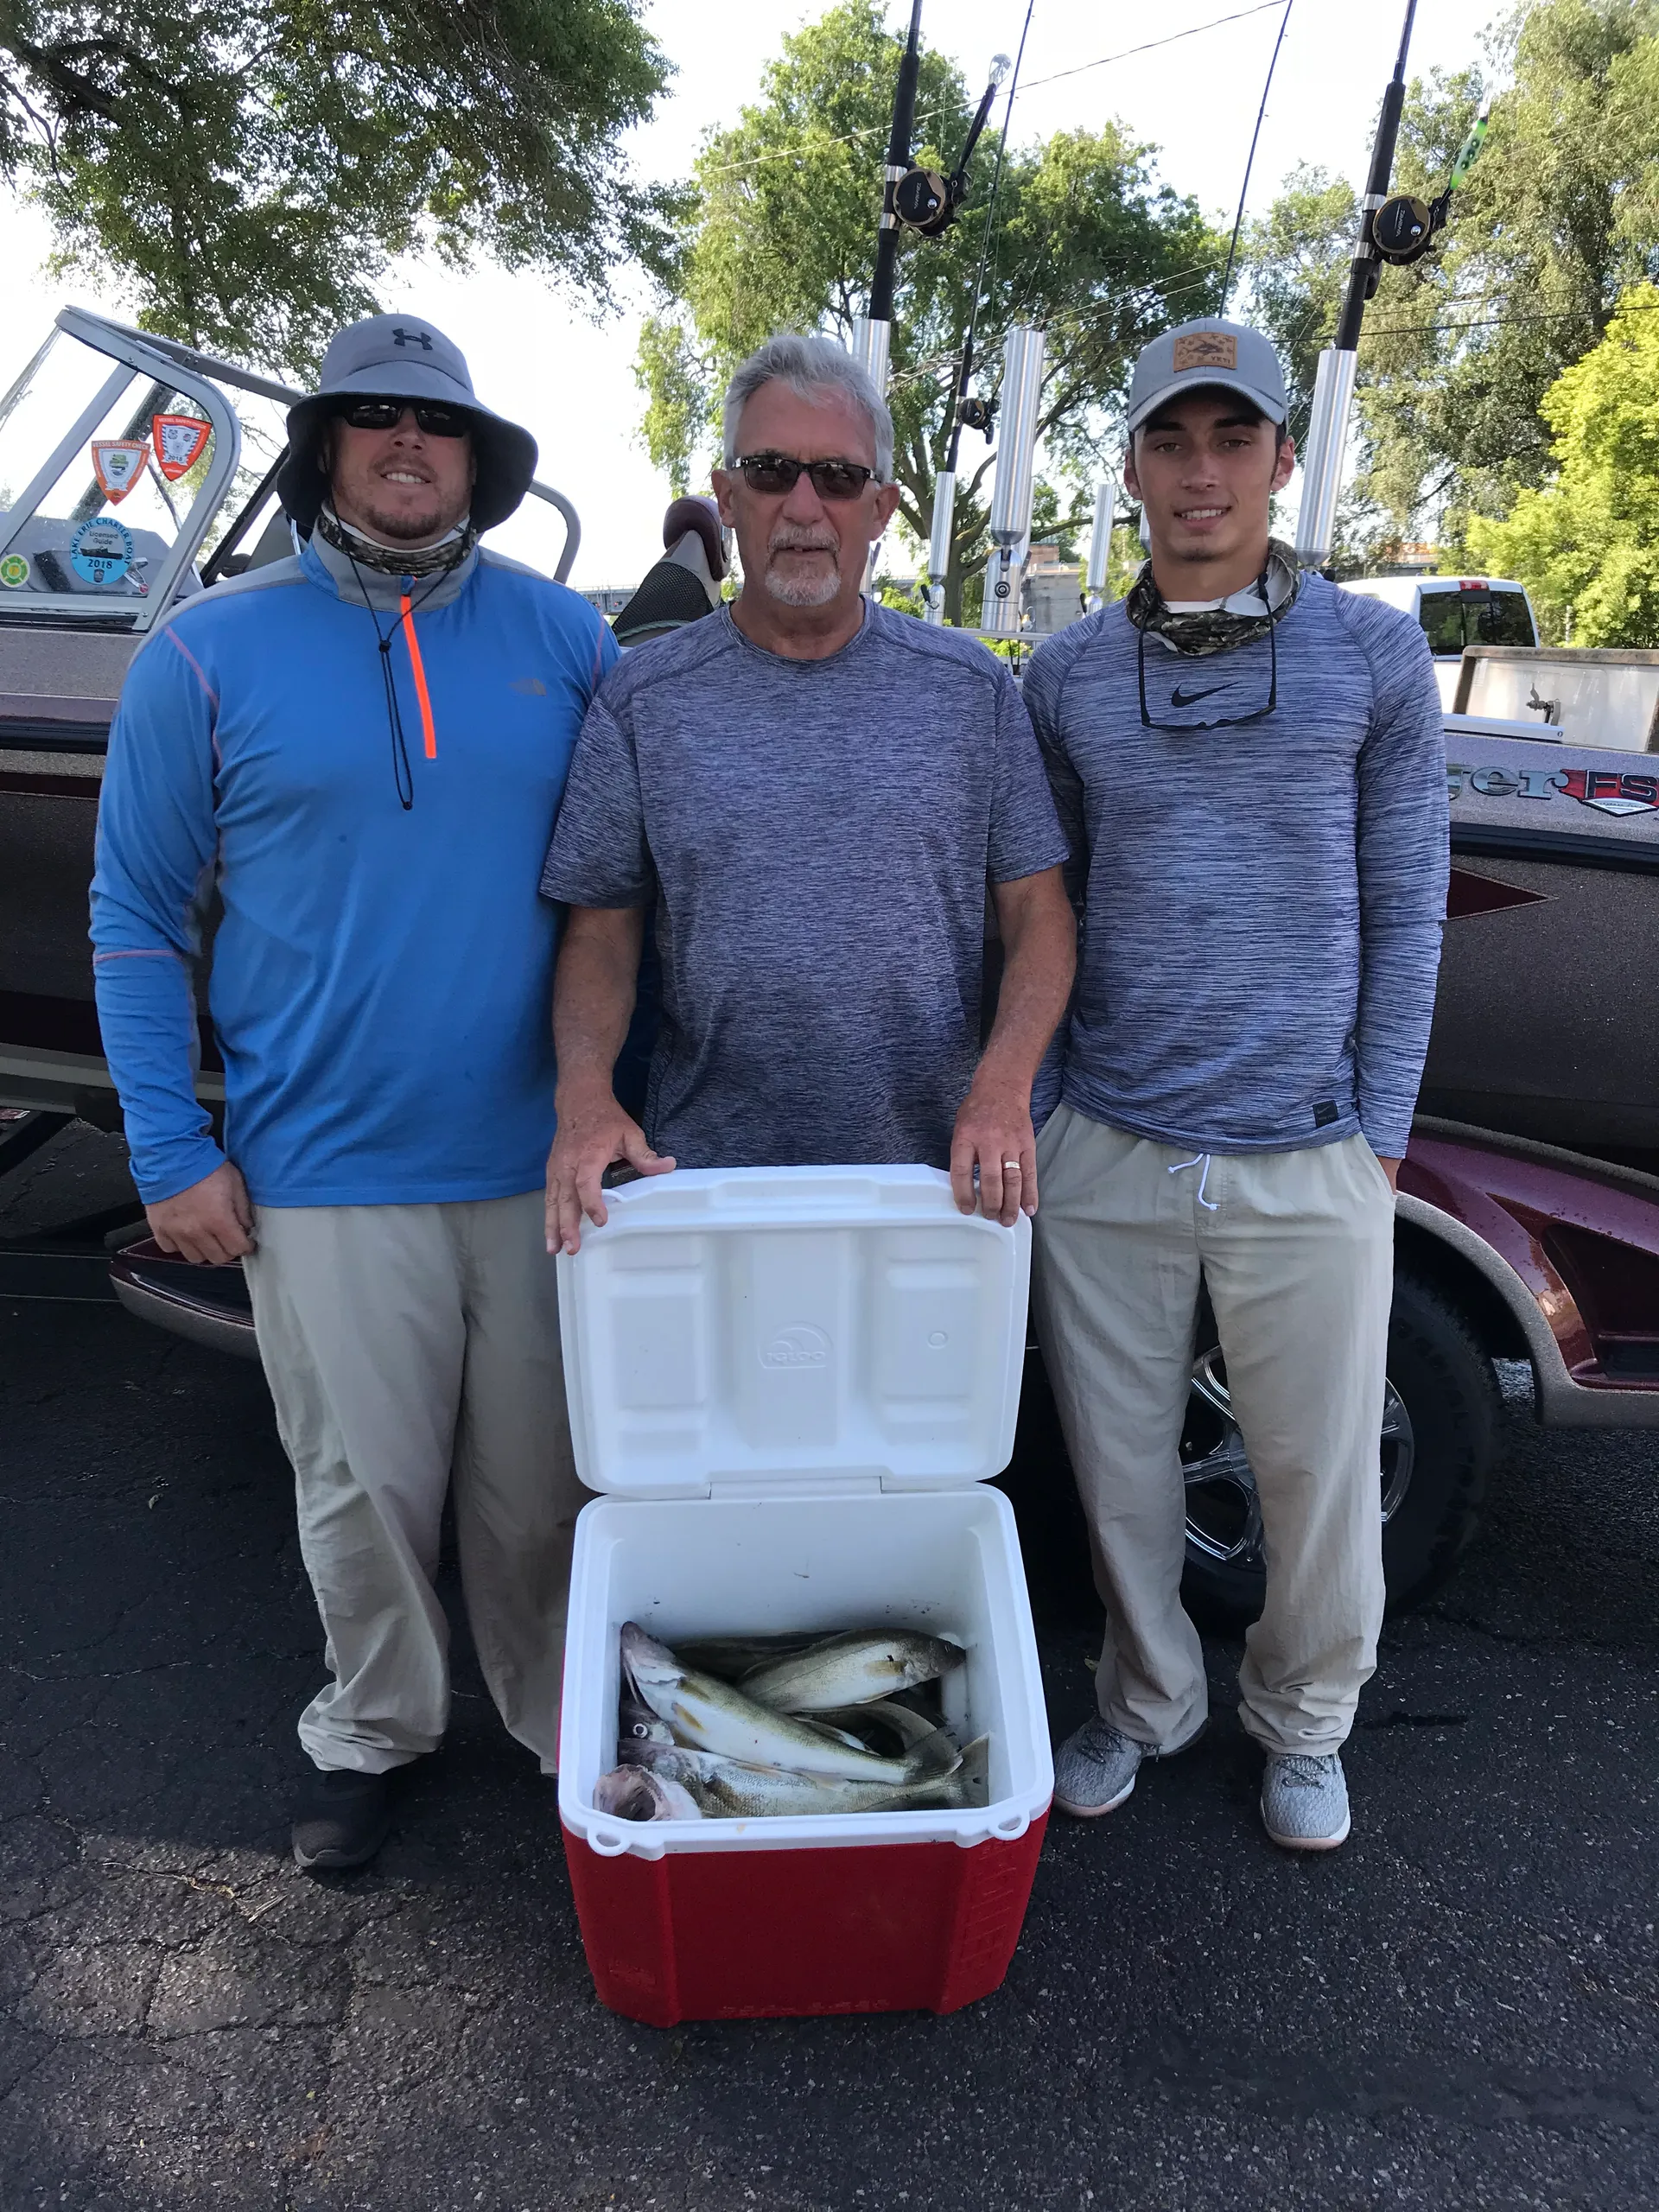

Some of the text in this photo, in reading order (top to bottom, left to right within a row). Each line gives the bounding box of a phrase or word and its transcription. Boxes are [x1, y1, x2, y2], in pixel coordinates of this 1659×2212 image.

[1211, 355, 1230, 364] YETI
[71, 518, 133, 566] LAKE ERIE CHARTER BOAT
[87, 558, 113, 569] 2018
[1585, 769, 1658, 804] FS
